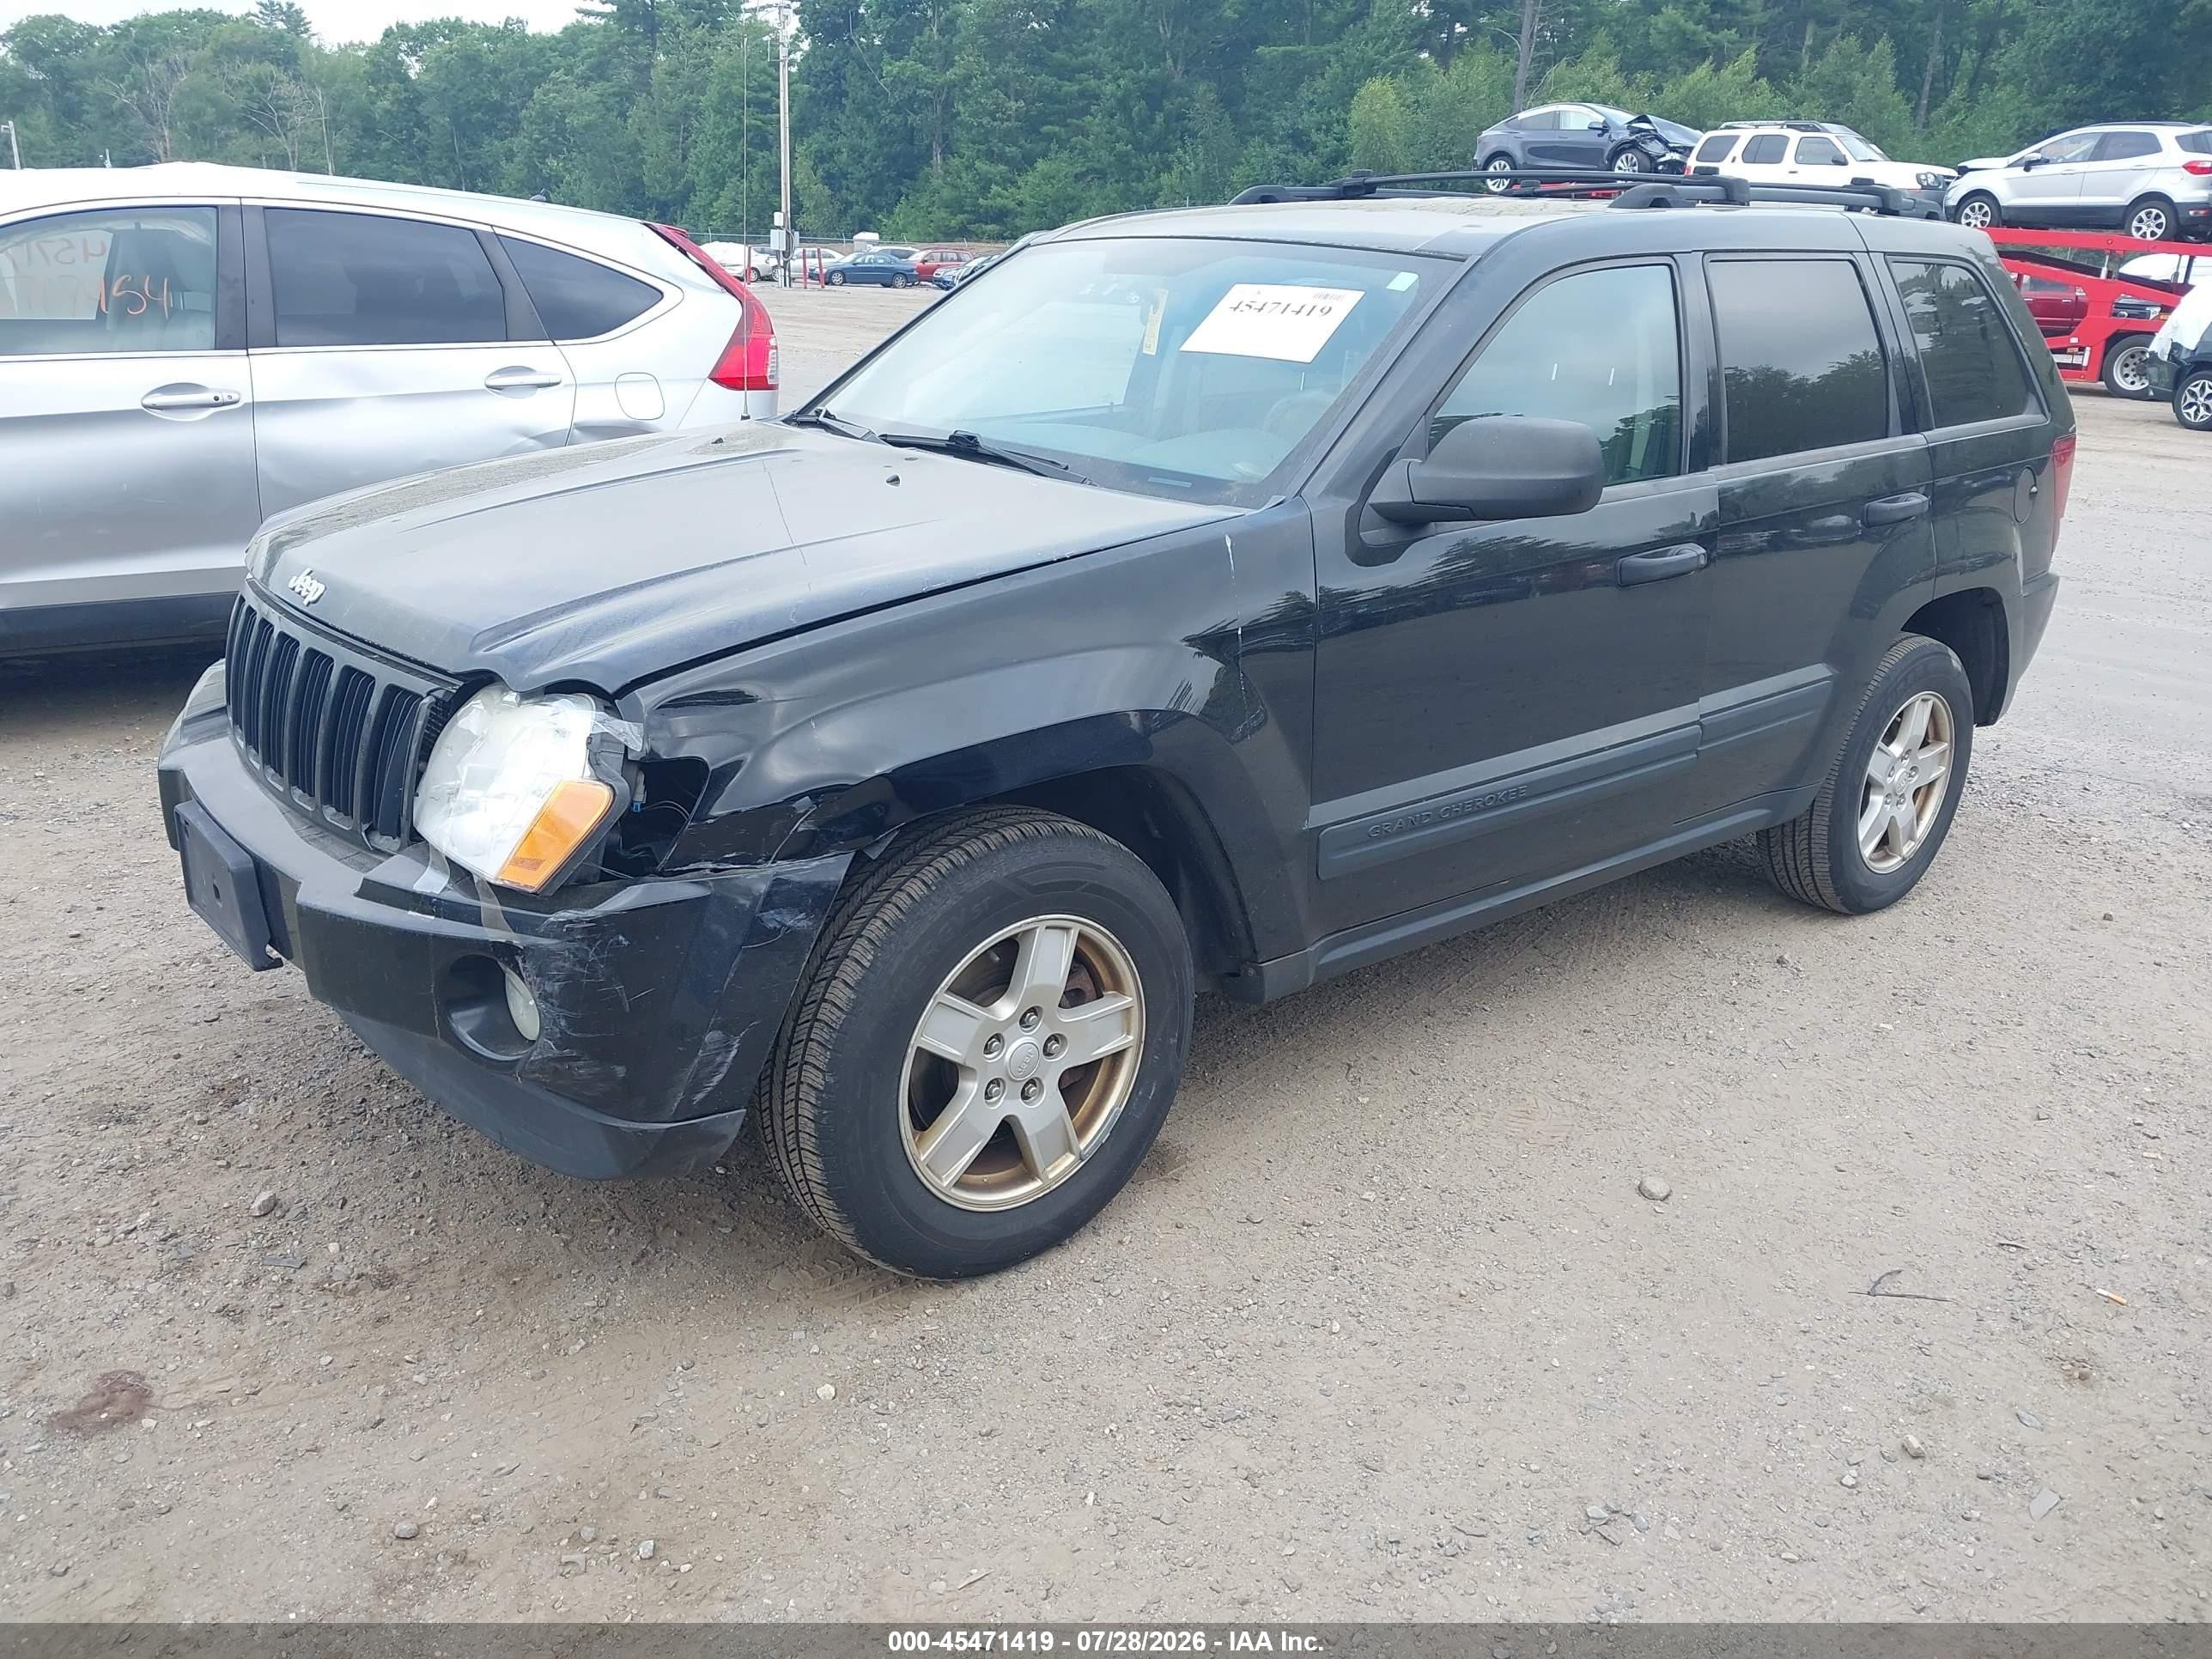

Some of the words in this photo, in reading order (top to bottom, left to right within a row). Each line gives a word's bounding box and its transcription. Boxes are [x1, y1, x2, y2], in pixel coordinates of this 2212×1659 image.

[289, 568, 327, 607] Jeep
[1367, 811, 1432, 838] GRAND
[1438, 786, 1528, 818] CHEROKEE
